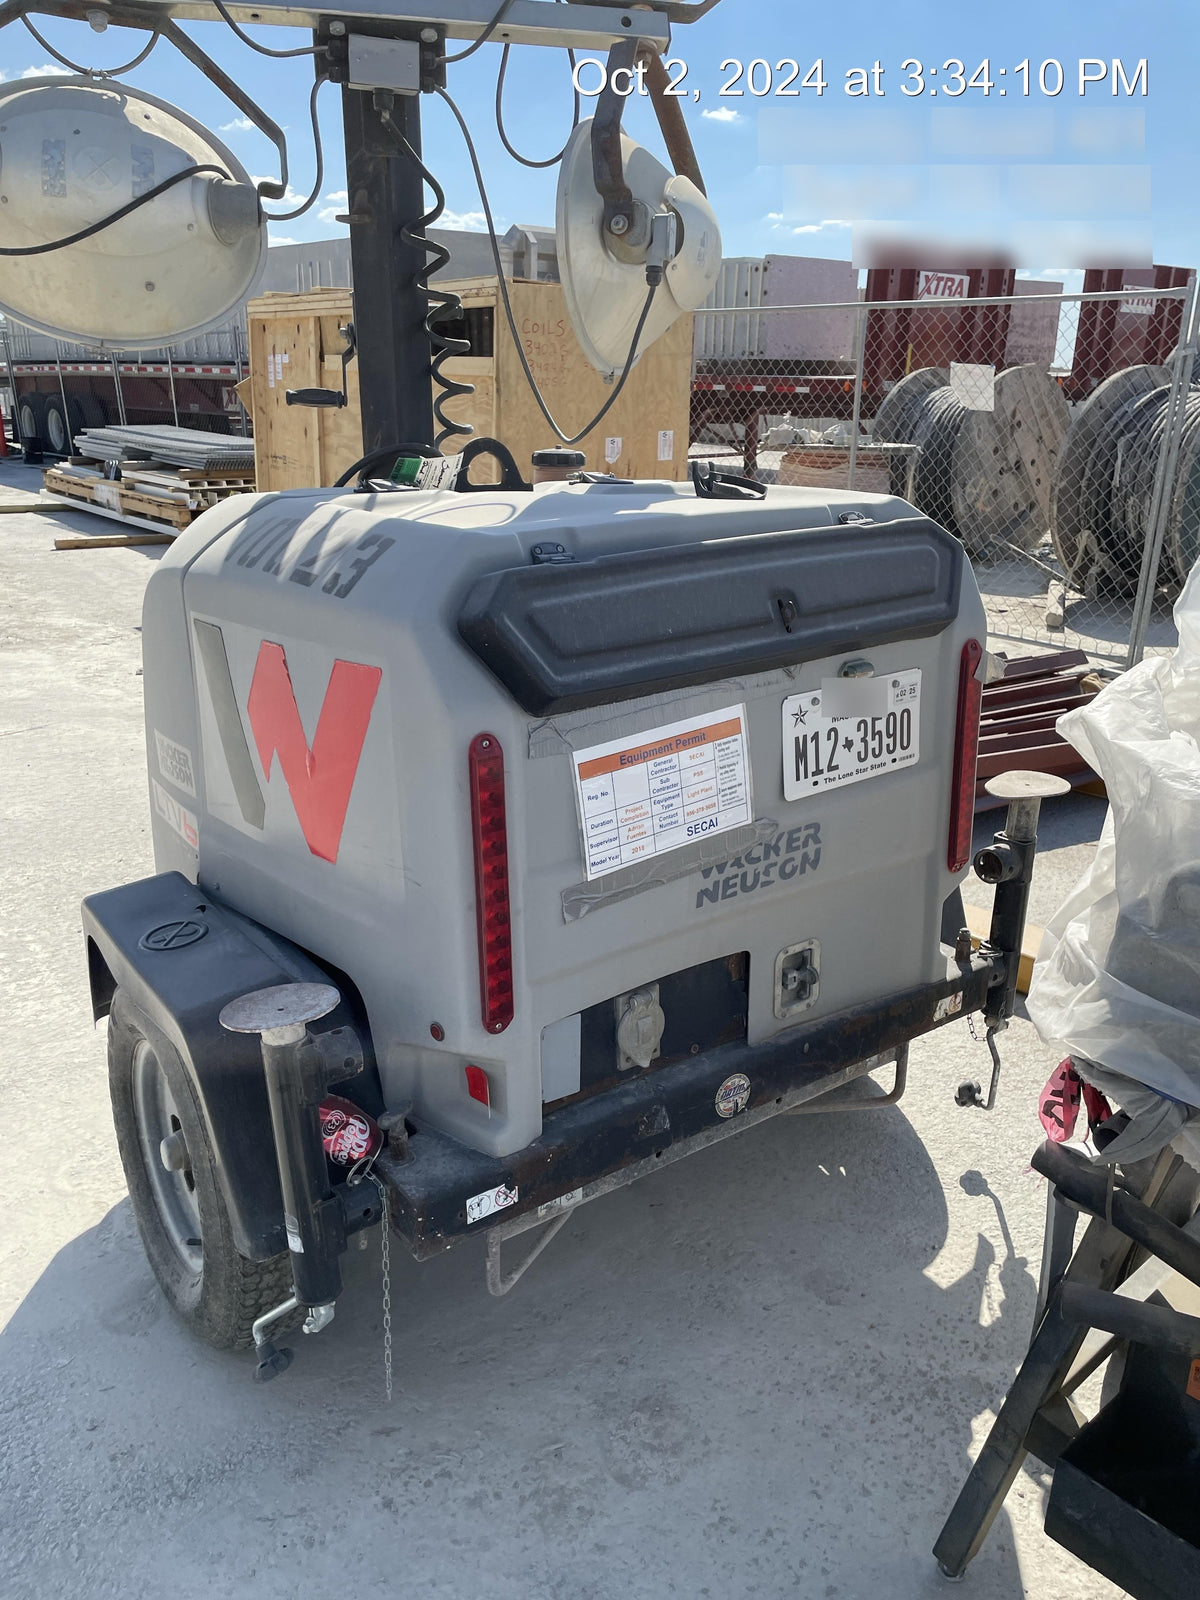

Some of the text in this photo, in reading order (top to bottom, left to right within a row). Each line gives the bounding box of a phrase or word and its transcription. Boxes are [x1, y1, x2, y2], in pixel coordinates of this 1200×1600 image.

[917, 273, 965, 299] XTRA
[521, 318, 566, 336] COILS
[908, 687, 916, 695] 25
[619, 732, 706, 766] Equipment Permit
[795, 727, 839, 782] M12
[856, 708, 911, 763] 3590
[653, 758, 674, 768] General
[689, 752, 705, 761] SECAI
[650, 763, 677, 776] Contractor
[823, 762, 887, 785] The Lone Star State
[652, 782, 679, 795] Contractor
[687, 786, 713, 799] Light Plant
[587, 792, 598, 801] Reg
[653, 793, 680, 807] Equipment
[625, 805, 643, 816] Project
[661, 802, 674, 811] Type
[590, 818, 614, 830] Duration
[620, 810, 649, 825] Completion
[658, 812, 679, 823] Contact
[659, 819, 679, 829] Number
[686, 817, 718, 837] SECAI
[626, 830, 647, 841] Fuentes
[589, 836, 618, 849] Supervisor
[590, 854, 620, 868] Model Year
[696, 847, 822, 908] NEUSON
[338, 1117, 370, 1165] Pepper
[349, 1139, 367, 1160] Dr
